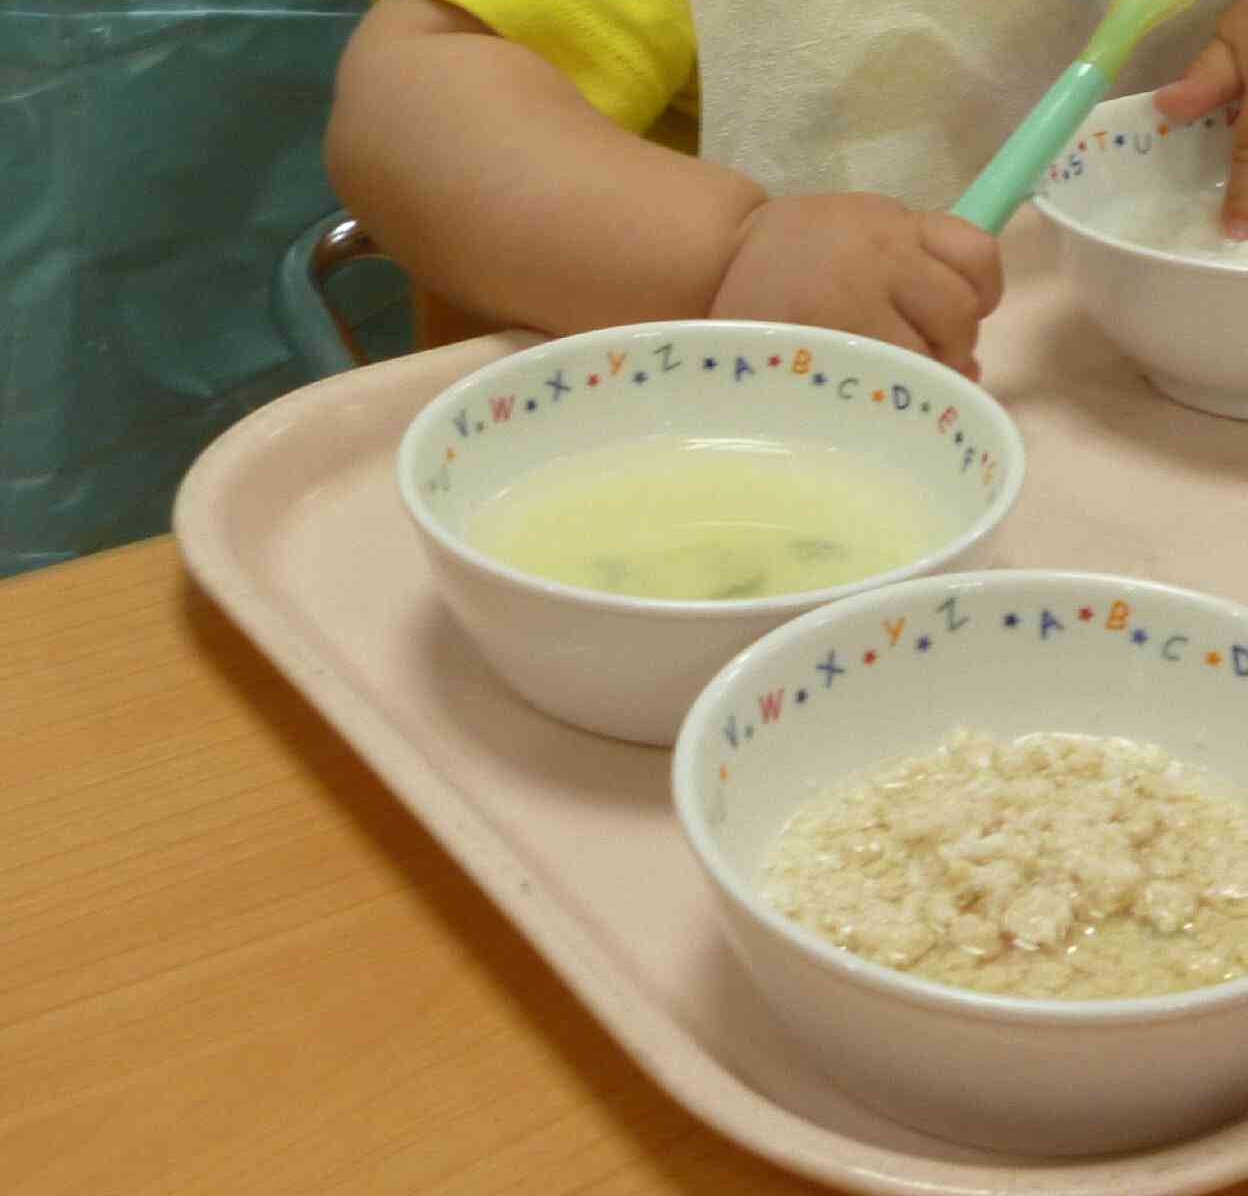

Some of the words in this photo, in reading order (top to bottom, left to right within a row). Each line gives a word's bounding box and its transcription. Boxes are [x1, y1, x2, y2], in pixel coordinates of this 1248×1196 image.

[1091, 130, 1108, 150] T
[1134, 132, 1153, 155] U
[488, 394, 515, 423] W
[544, 369, 572, 402] X
[606, 350, 627, 377] Y
[653, 343, 682, 372] Z
[734, 356, 756, 382] A
[791, 348, 812, 375] B
[837, 377, 859, 401] C
[891, 384, 911, 410] D
[937, 405, 959, 435] E
[759, 688, 784, 724] W
[815, 649, 845, 688] X
[882, 616, 906, 647] Y
[937, 596, 970, 632] Z
[1039, 609, 1064, 641] A
[1104, 599, 1130, 631] B
[1161, 635, 1188, 661] C
